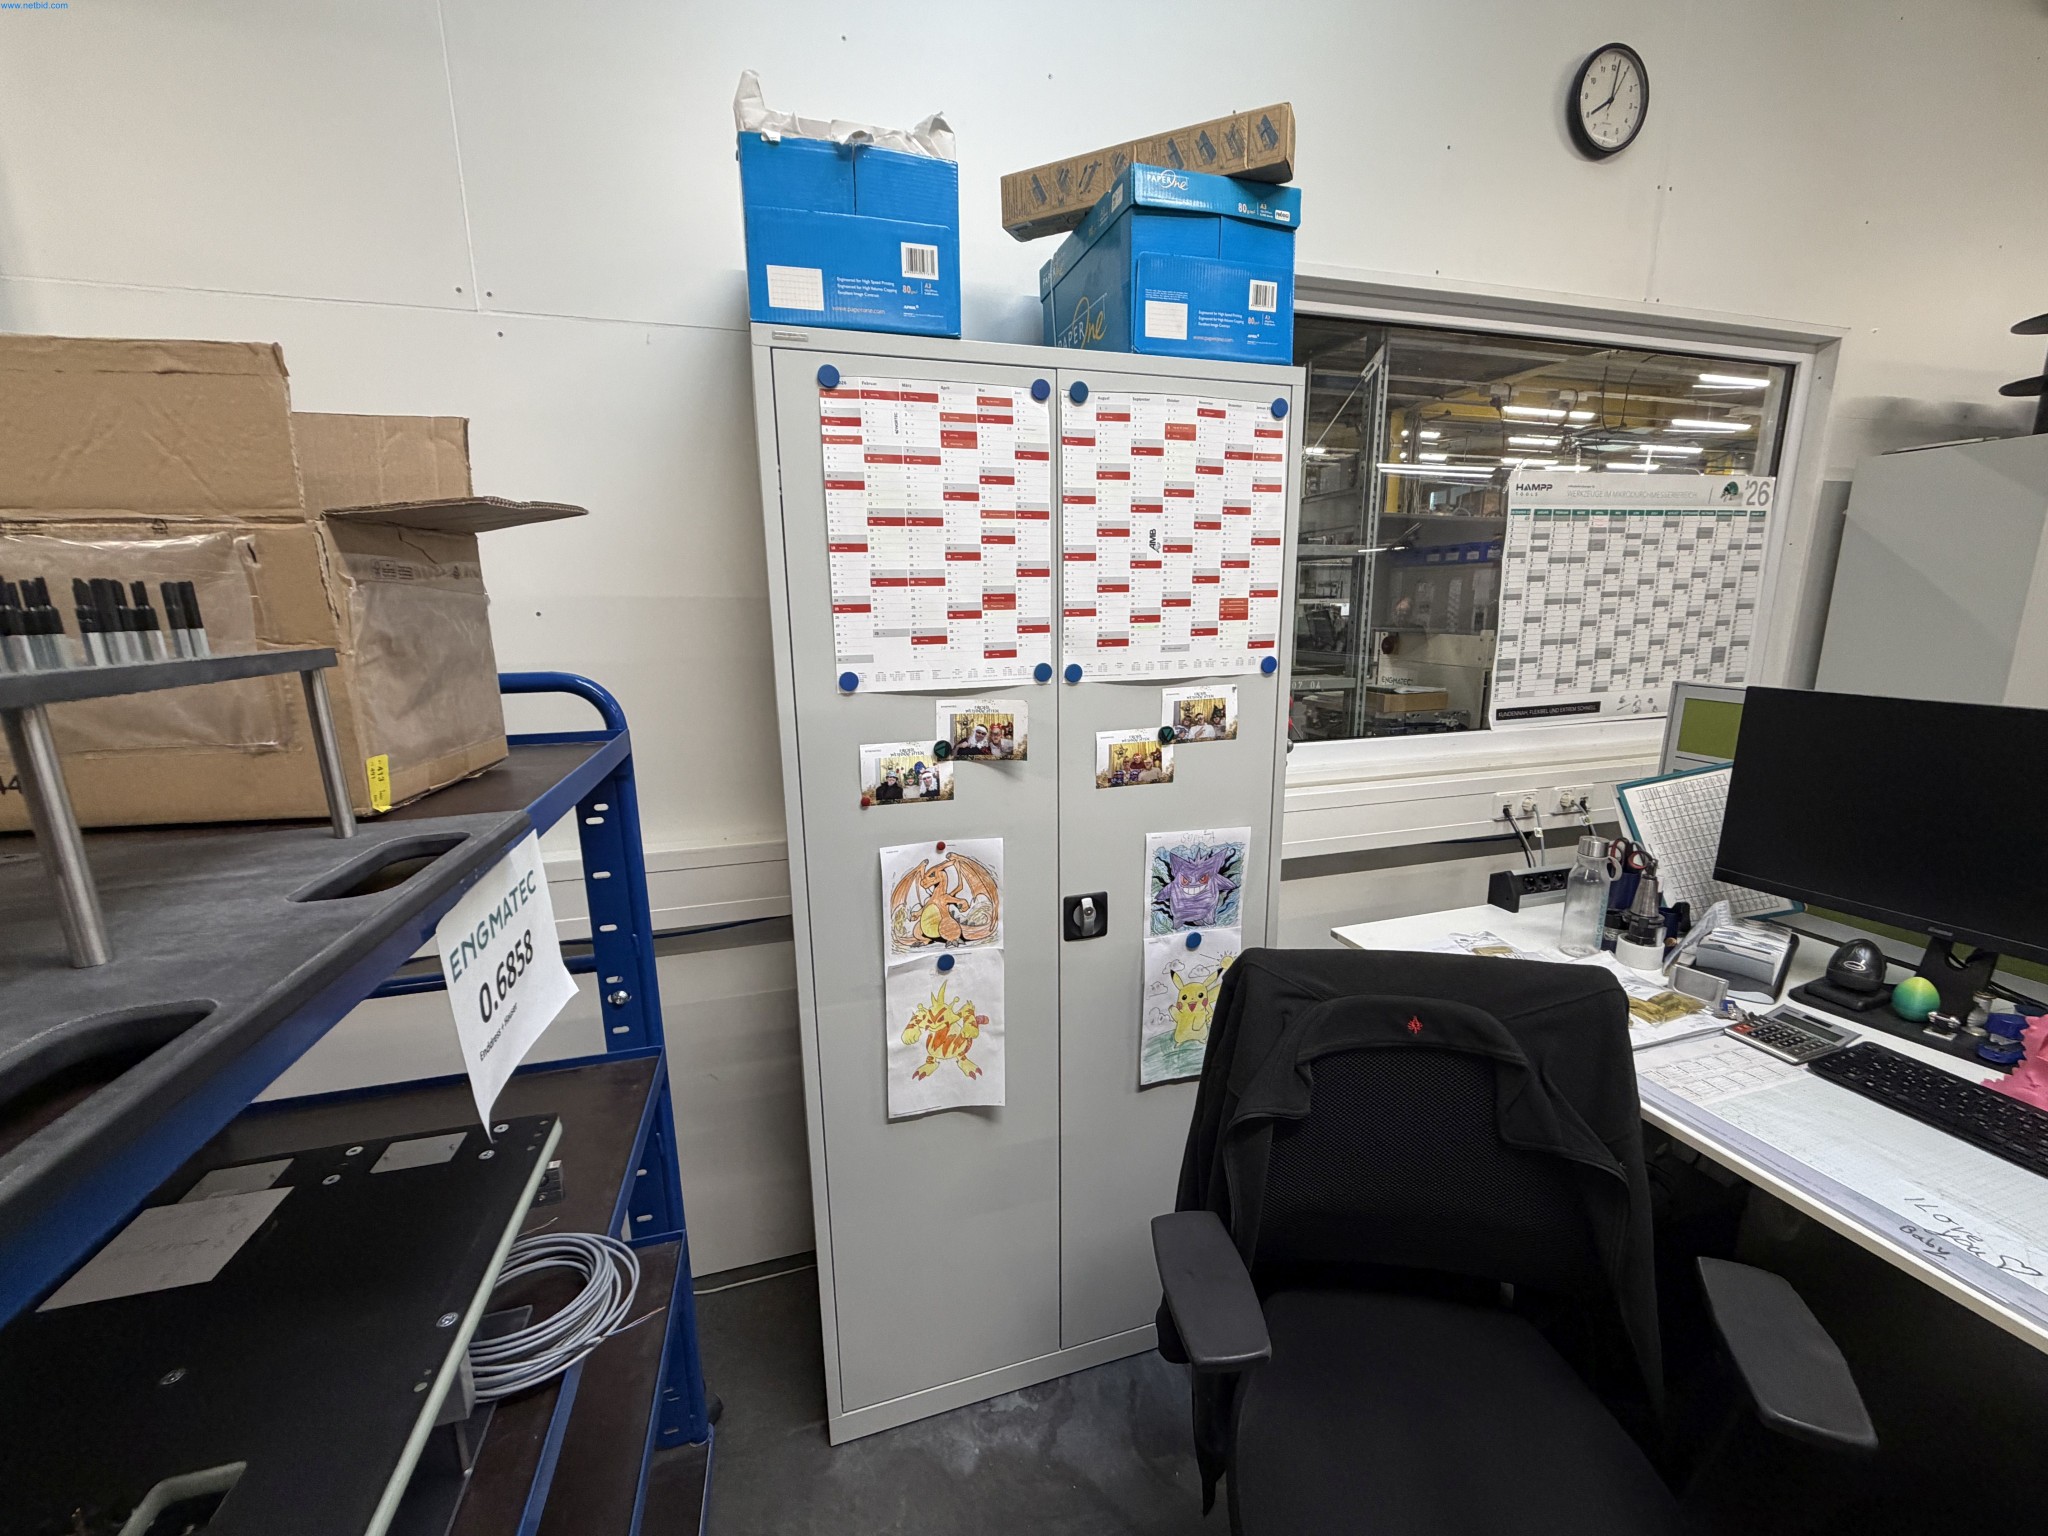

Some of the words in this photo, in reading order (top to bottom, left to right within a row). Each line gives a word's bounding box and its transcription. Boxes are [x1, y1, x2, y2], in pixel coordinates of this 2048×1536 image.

[1238, 202, 1247, 212] 80
[902, 285, 911, 294] 80
[1149, 529, 1160, 553] AMB
[449, 870, 537, 983] ENGMATEC
[479, 928, 534, 1023] 0.6858
[1899, 1224, 1950, 1260] Baby
[1923, 1228, 1986, 1257] you
